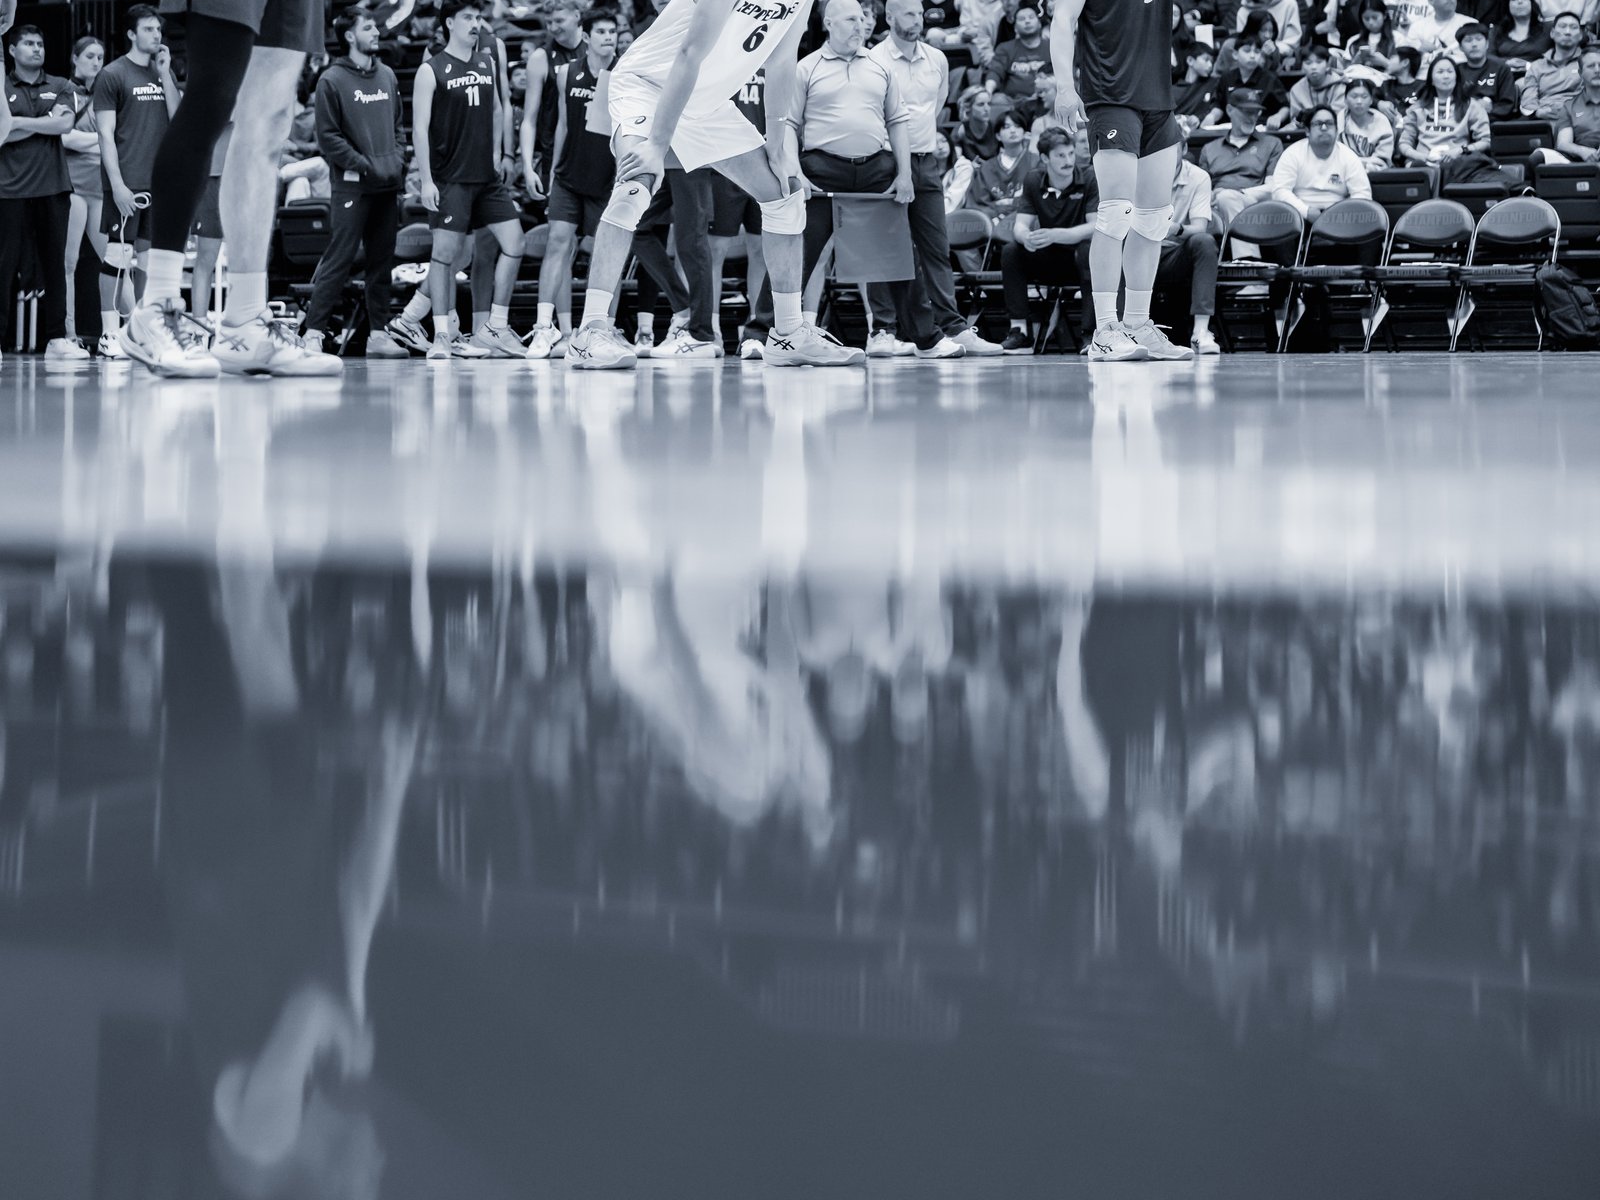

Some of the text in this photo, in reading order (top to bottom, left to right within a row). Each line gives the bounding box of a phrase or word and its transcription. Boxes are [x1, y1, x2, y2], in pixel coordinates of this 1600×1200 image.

[742, 23, 768, 53] 6
[447, 70, 493, 90] PEPPERDINE
[464, 85, 480, 107] 11
[739, 84, 760, 105] 44
[1238, 211, 1294, 225] STANFORD
[1322, 210, 1379, 224] STANFORD
